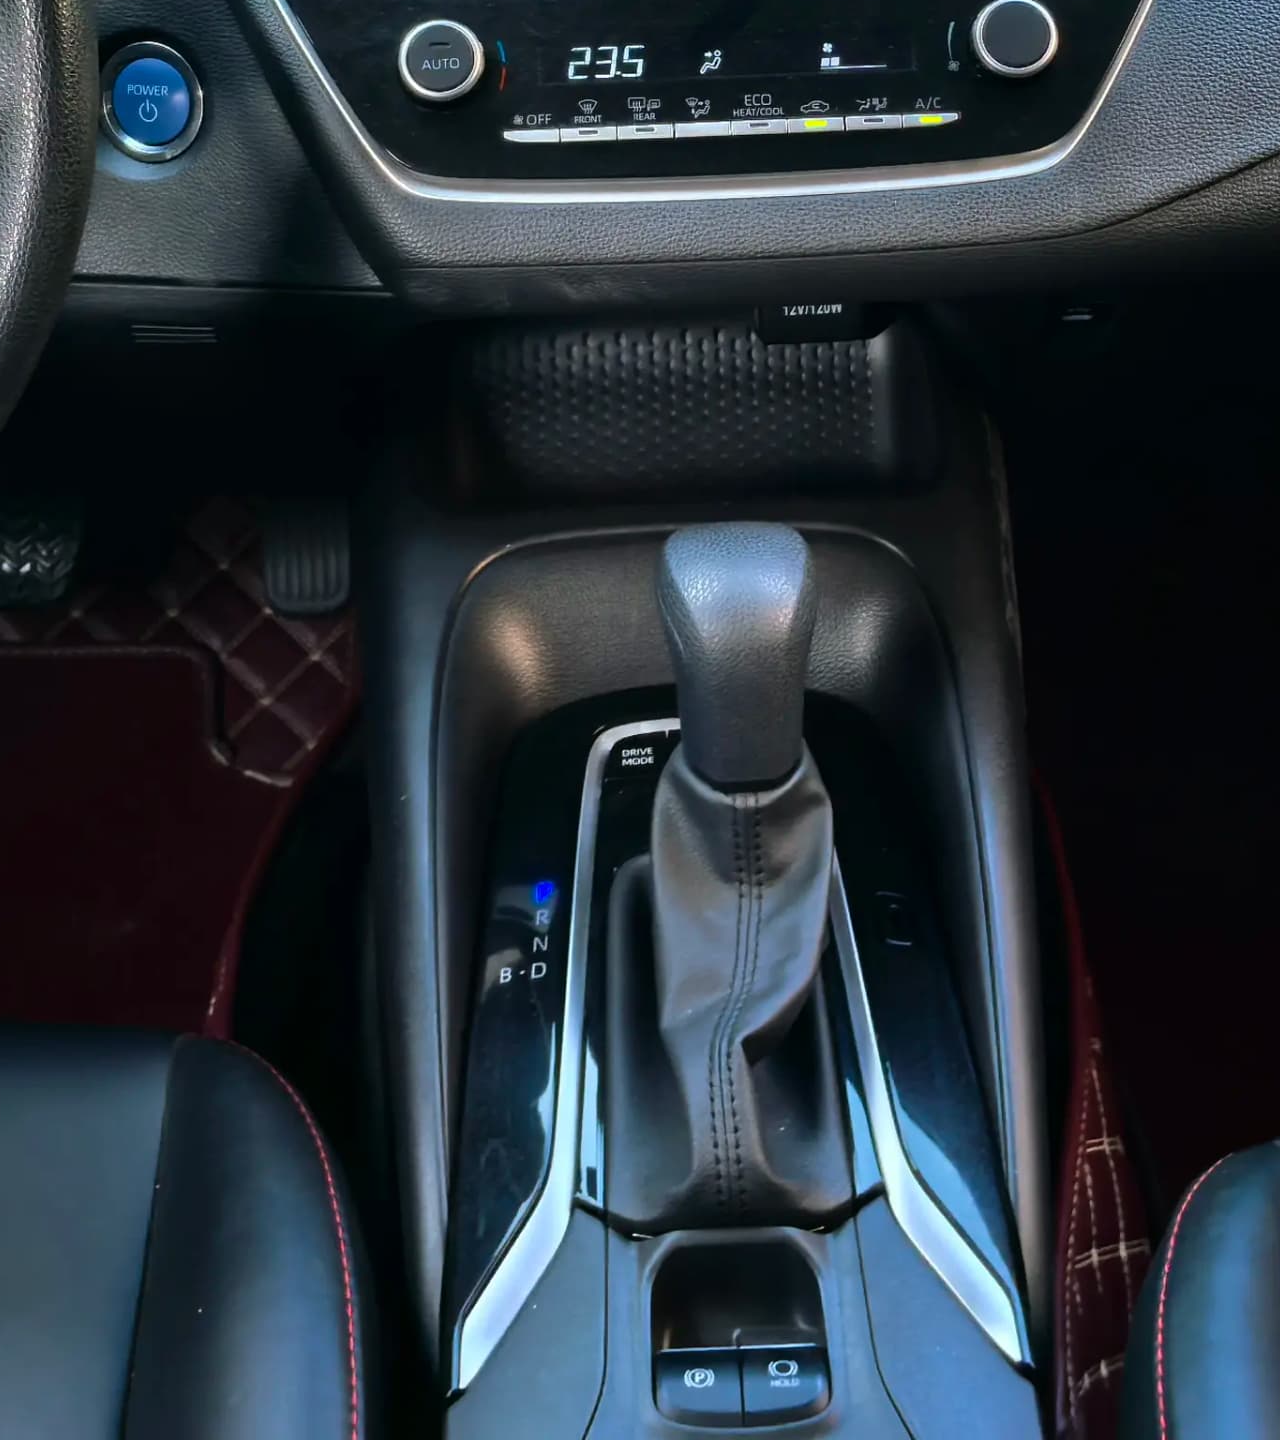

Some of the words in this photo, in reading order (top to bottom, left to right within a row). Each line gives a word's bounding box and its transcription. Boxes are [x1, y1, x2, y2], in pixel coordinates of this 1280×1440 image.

[421, 57, 460, 71] AUTO
[127, 83, 169, 96] POWER
[744, 94, 771, 107] ECO
[915, 97, 942, 109] A/C
[633, 112, 656, 121] REAR
[733, 107, 784, 117] HEAT/COOL
[526, 114, 552, 125] OFF
[574, 114, 602, 124] FRONT
[622, 746, 654, 758] DRIVE
[622, 756, 655, 767] MODE
[536, 909, 550, 926] R
[533, 935, 548, 953] N
[499, 967, 512, 984] B
[531, 962, 547, 979] D
[770, 1378, 800, 1388] HOLD
